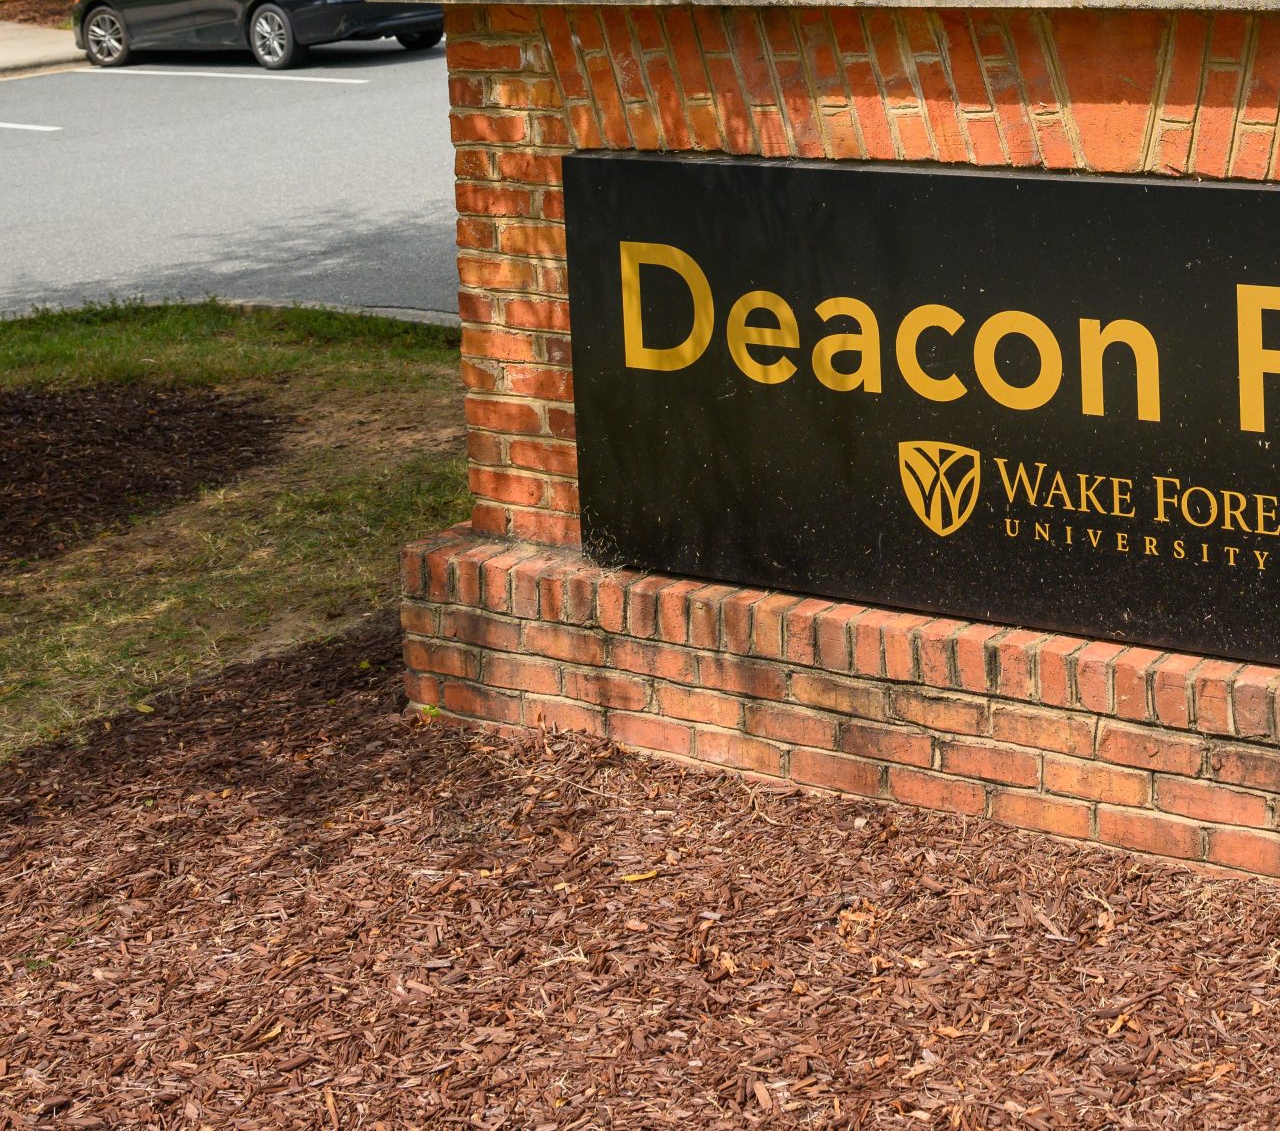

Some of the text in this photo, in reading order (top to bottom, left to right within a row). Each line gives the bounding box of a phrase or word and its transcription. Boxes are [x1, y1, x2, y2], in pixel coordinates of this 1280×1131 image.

[619, 241, 1161, 423] Deacon
[993, 457, 1137, 519] WAKE
[1004, 518, 1270, 570] UNIVERSITY
